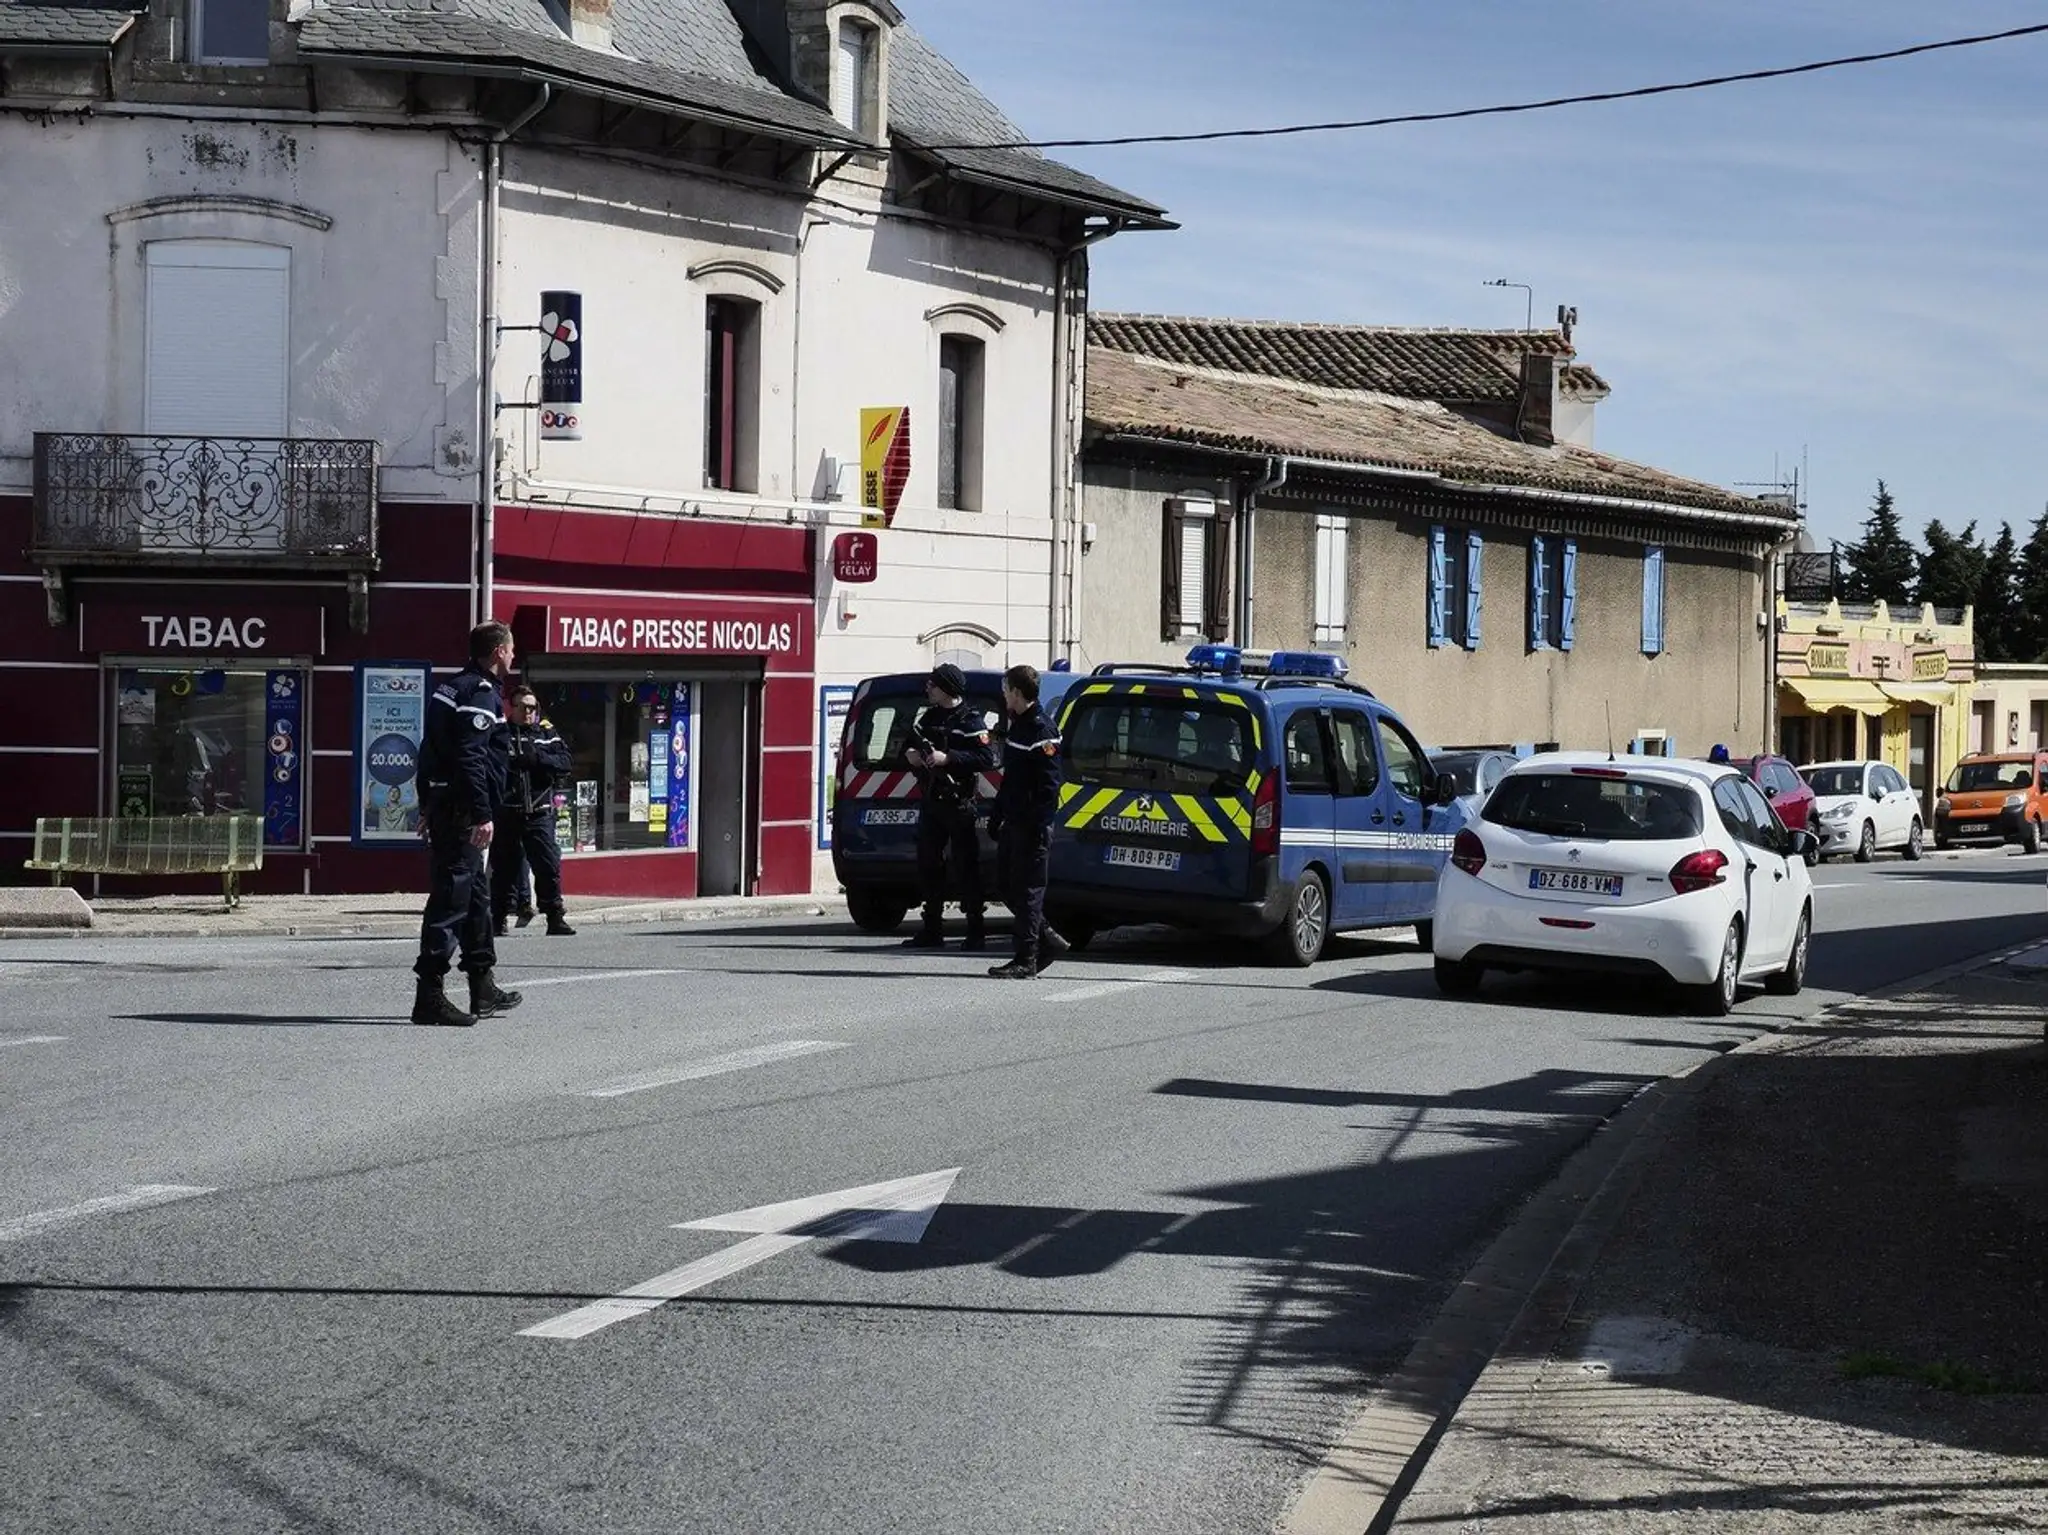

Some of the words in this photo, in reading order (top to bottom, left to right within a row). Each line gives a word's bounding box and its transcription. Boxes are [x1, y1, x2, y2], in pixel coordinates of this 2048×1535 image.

[141, 616, 266, 648] TABAC
[559, 617, 627, 647] TABAC
[632, 619, 708, 649] PRESSE
[713, 620, 791, 652] NICOLAS
[386, 707, 401, 717] ICI
[1100, 816, 1189, 837] GENDARMERIE
[1539, 872, 1613, 892] DZ-688-VM
